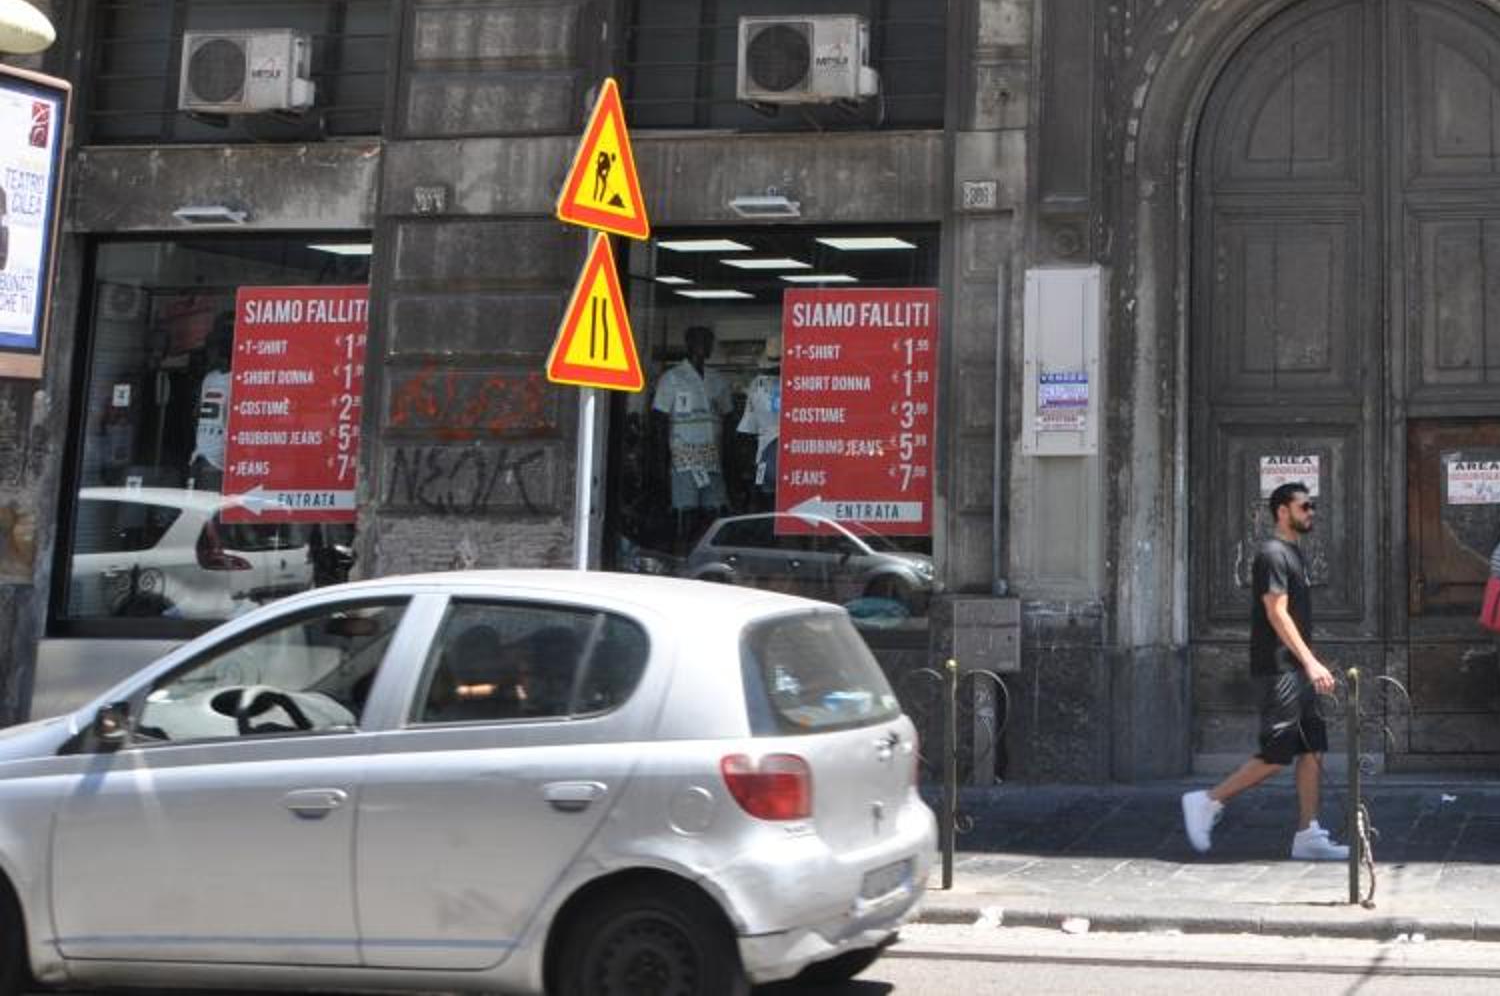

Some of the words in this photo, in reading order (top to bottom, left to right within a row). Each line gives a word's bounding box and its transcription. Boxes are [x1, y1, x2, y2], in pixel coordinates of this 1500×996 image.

[244, 299, 303, 325] SIAMO
[792, 302, 855, 327] SIAMO
[860, 301, 929, 327] FALLITI
[245, 339, 288, 354] T-SHIRT
[795, 344, 841, 359] T-SHIRT
[243, 370, 276, 385] SHORT
[278, 369, 315, 384] DONNA
[792, 377, 830, 391] SHORT
[831, 375, 871, 391] DONNA
[792, 407, 846, 423] COSTUME
[238, 431, 288, 445] GIUBBINO
[290, 430, 322, 445] JEANS
[790, 439, 844, 454] GIUBBINO
[845, 439, 884, 456] JEANS
[235, 461, 270, 476] JEANS
[791, 471, 826, 486] JEANS
[277, 492, 335, 508] ENTRATA
[836, 504, 900, 519] ENTRATA
